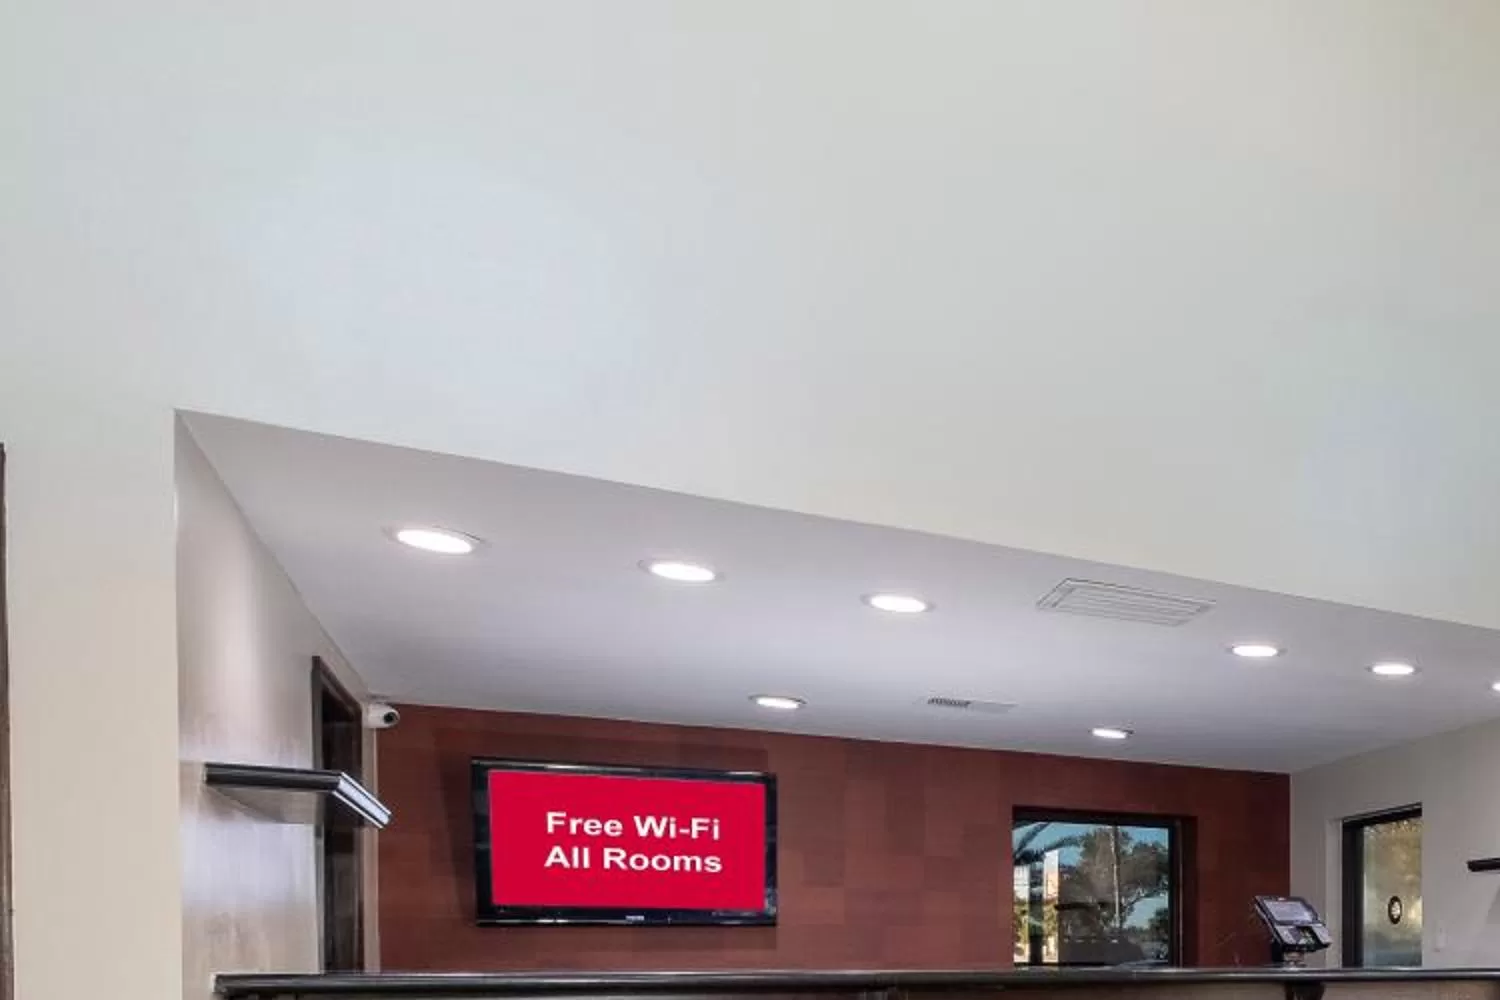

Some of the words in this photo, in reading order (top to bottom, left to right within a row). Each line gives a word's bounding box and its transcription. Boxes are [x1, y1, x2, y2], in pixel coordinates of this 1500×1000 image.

[546, 811, 623, 836] Free
[633, 815, 720, 840] Wi-Fi
[544, 845, 590, 869] All
[603, 847, 722, 872] Rooms
